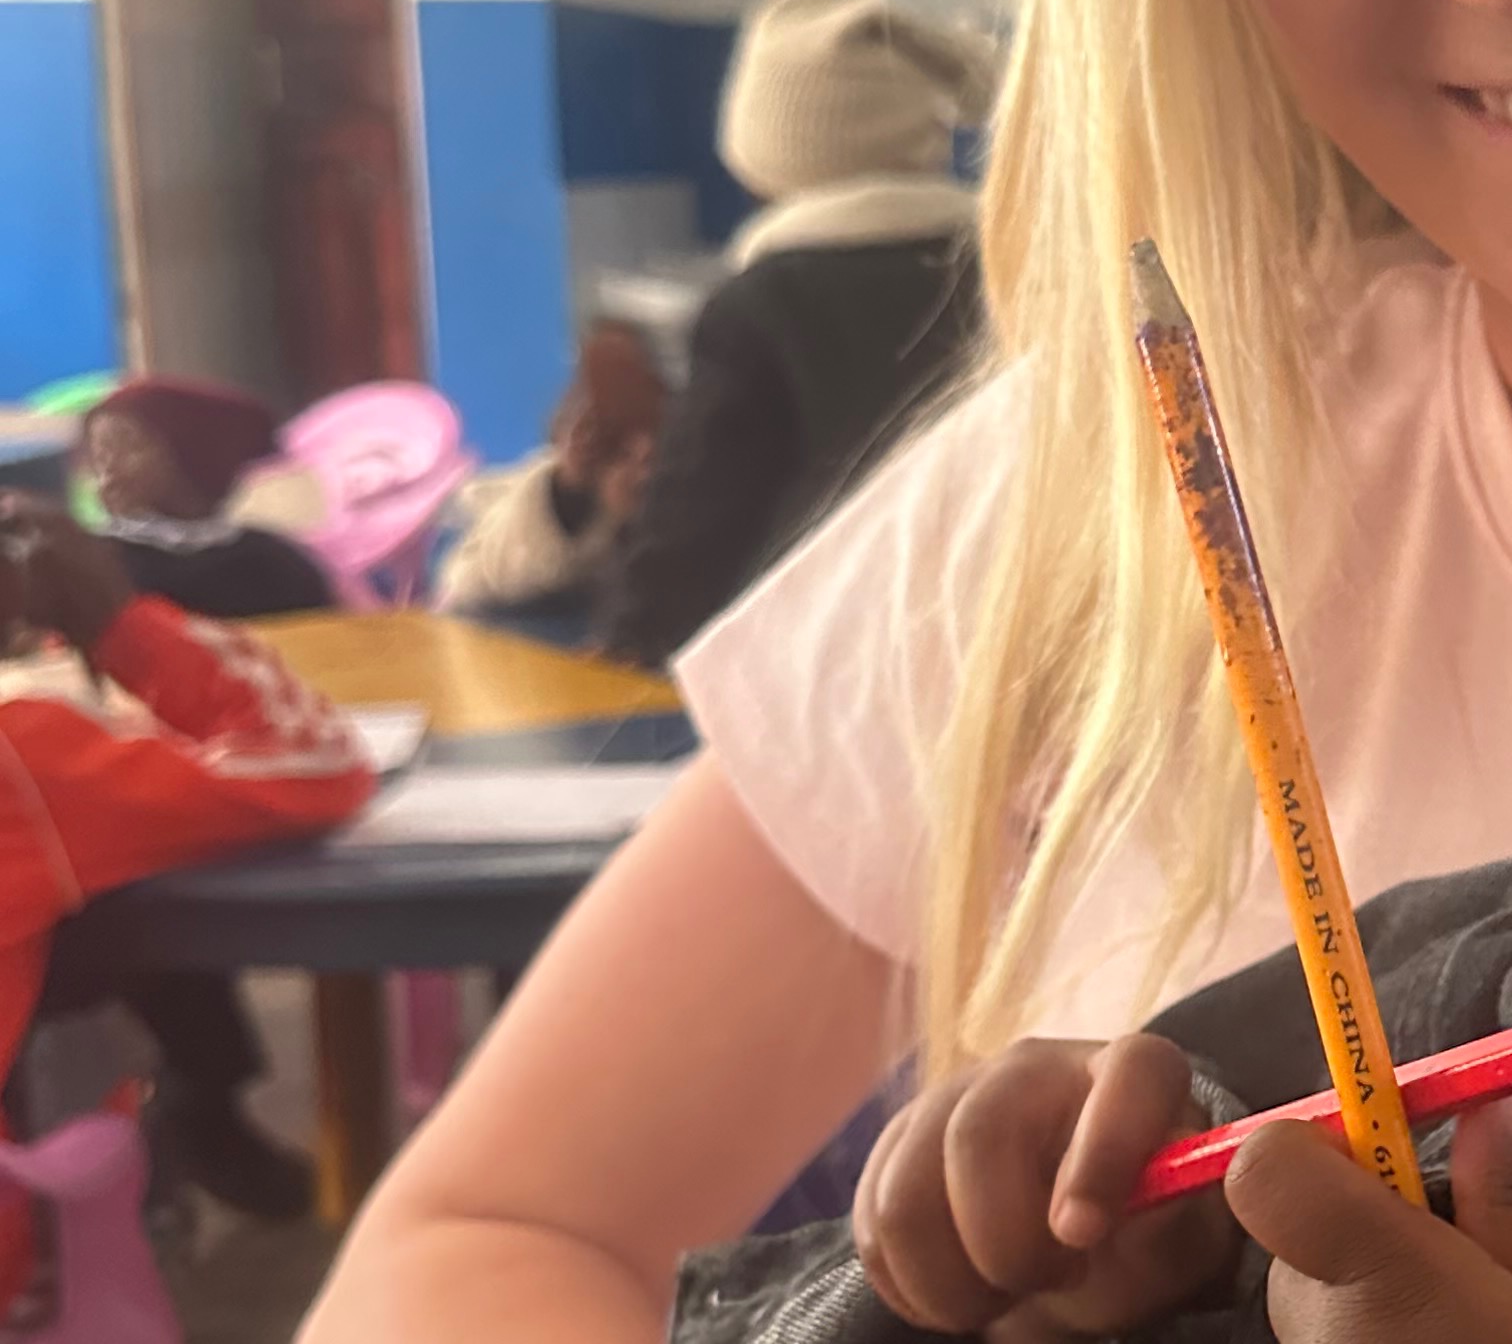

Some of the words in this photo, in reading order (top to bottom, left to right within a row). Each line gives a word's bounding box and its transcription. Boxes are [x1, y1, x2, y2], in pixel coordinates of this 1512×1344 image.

[1278, 778, 1324, 900] MADE
[1313, 911, 1339, 954] IN
[1330, 971, 1375, 1104] CHINA
